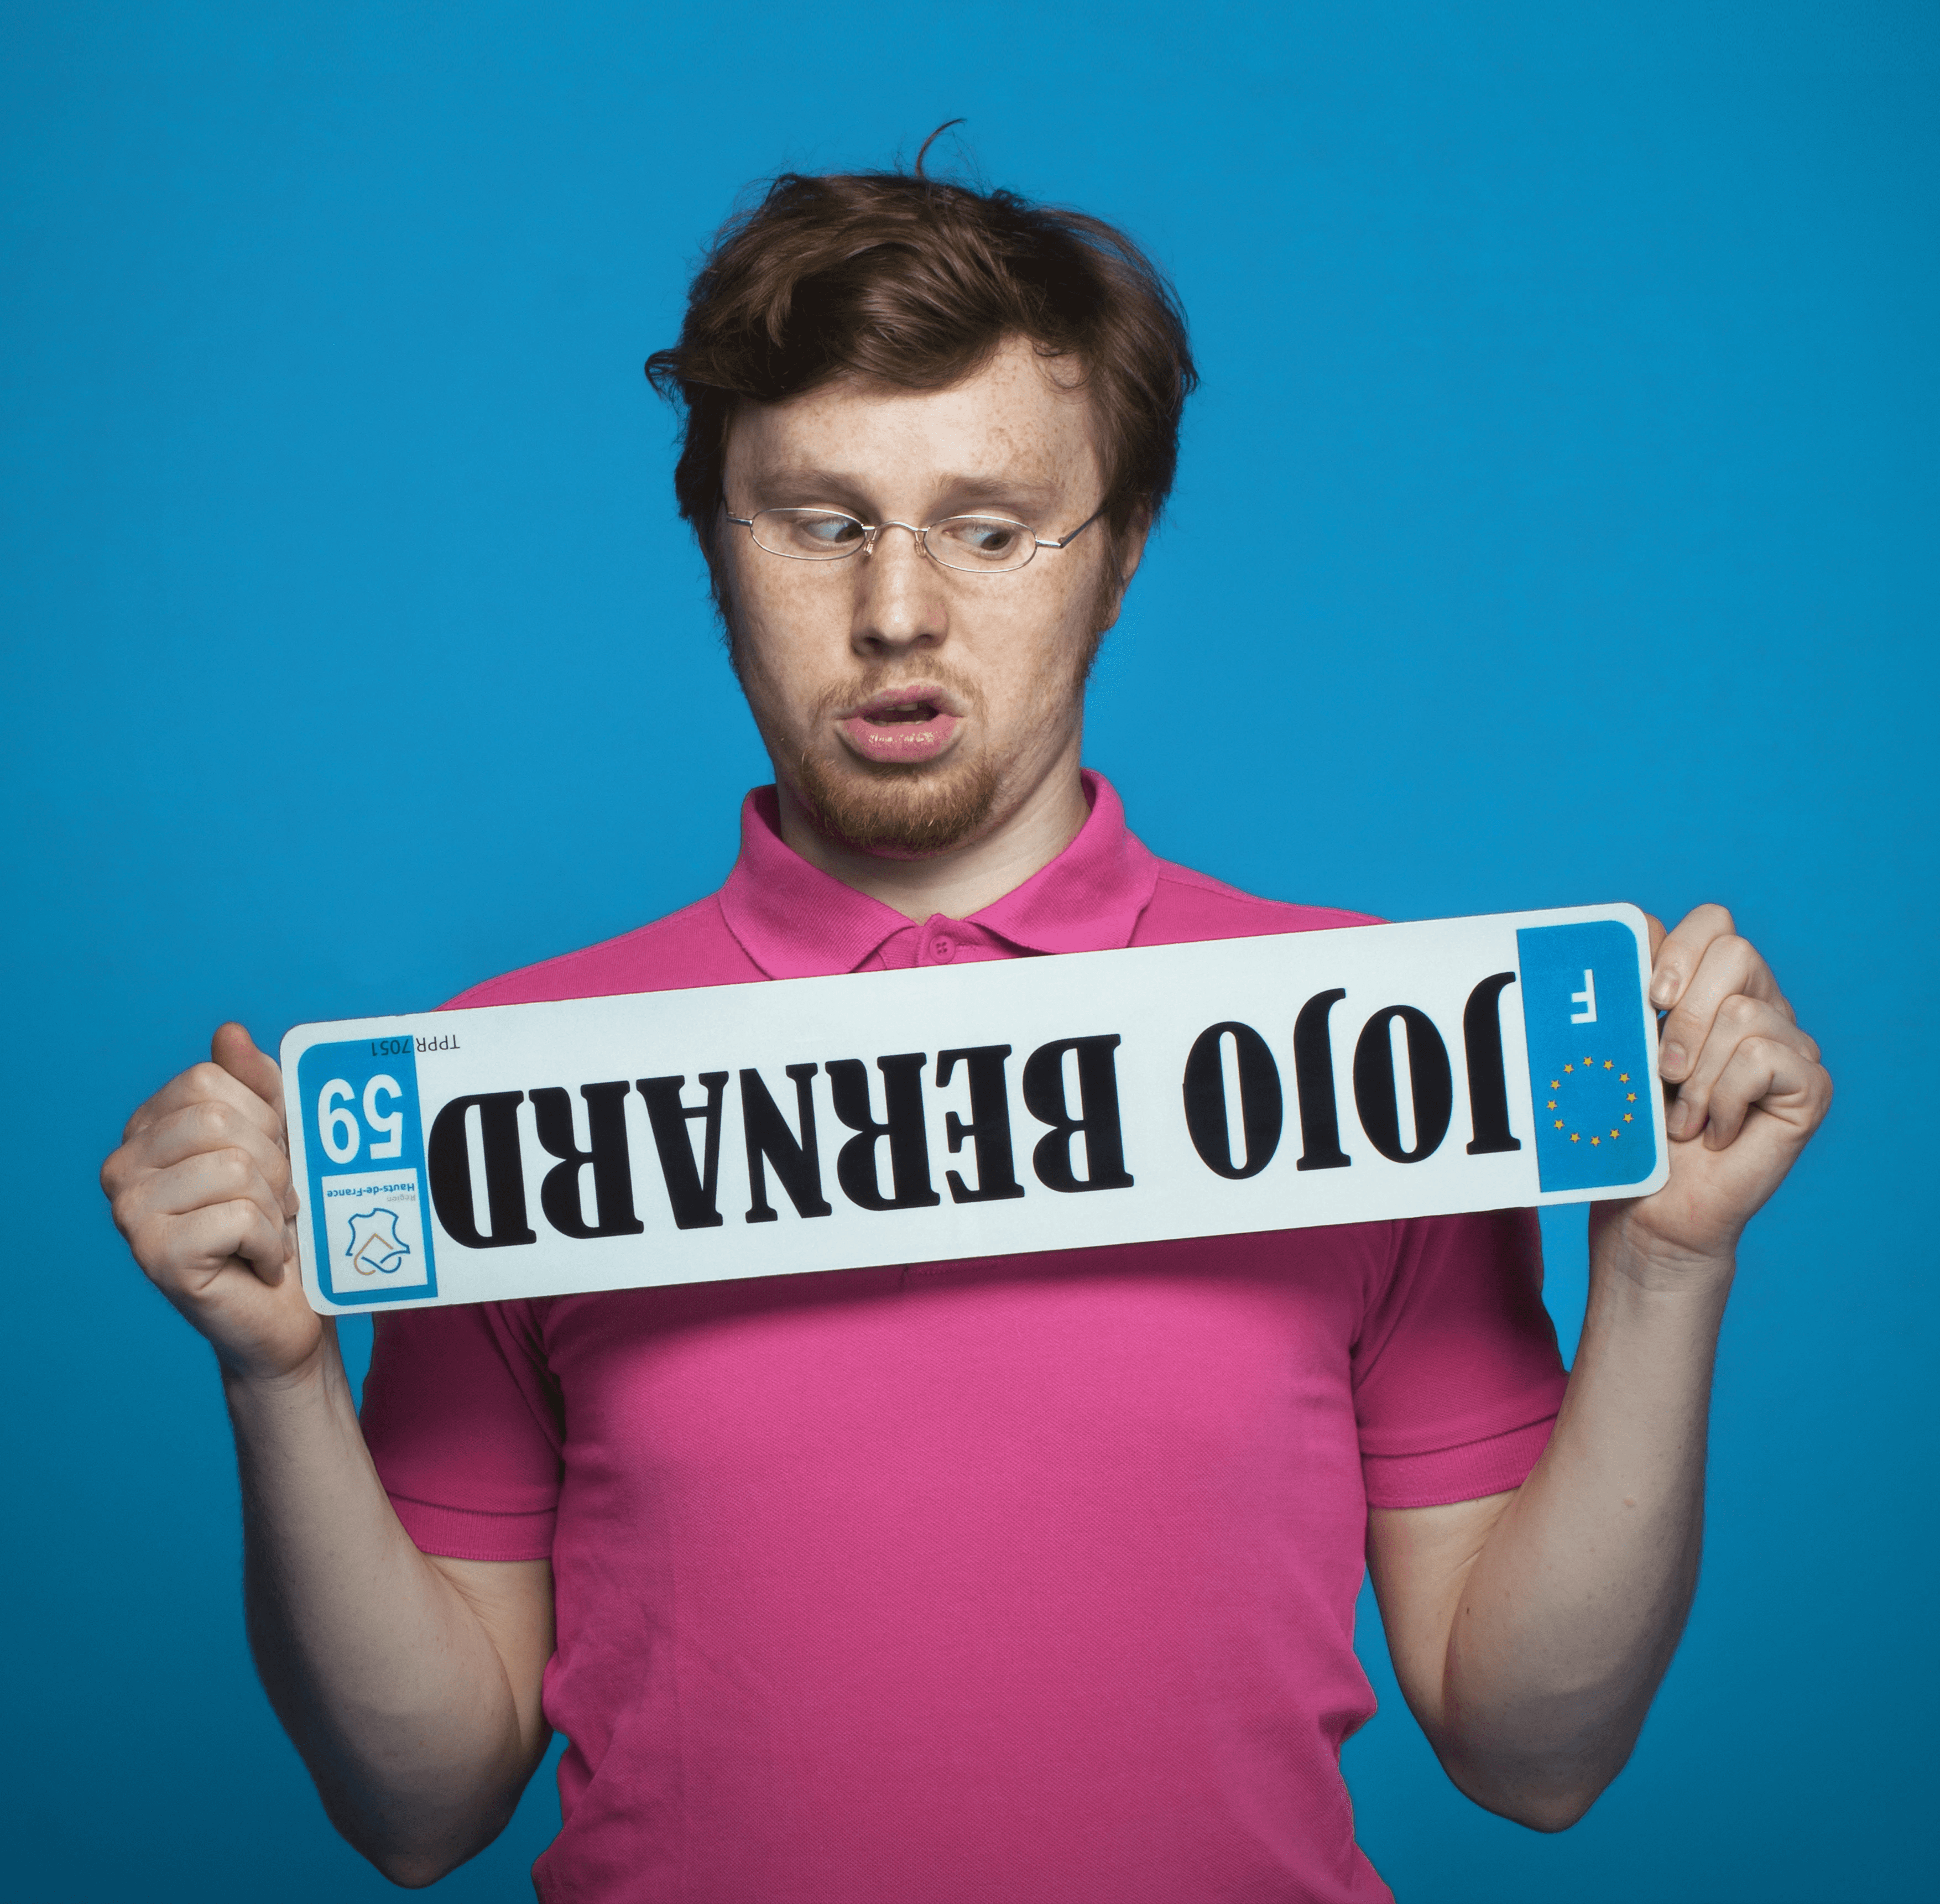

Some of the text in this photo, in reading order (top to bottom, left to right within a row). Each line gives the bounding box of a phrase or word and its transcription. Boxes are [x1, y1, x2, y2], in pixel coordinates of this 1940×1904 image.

[1570, 969, 1598, 1024] F
[371, 1034, 460, 1057] TPPR 7051
[318, 1074, 403, 1164] 59
[428, 972, 1521, 1249] JOJO BERNARD
[327, 1183, 415, 1198] Hauts-de-France
